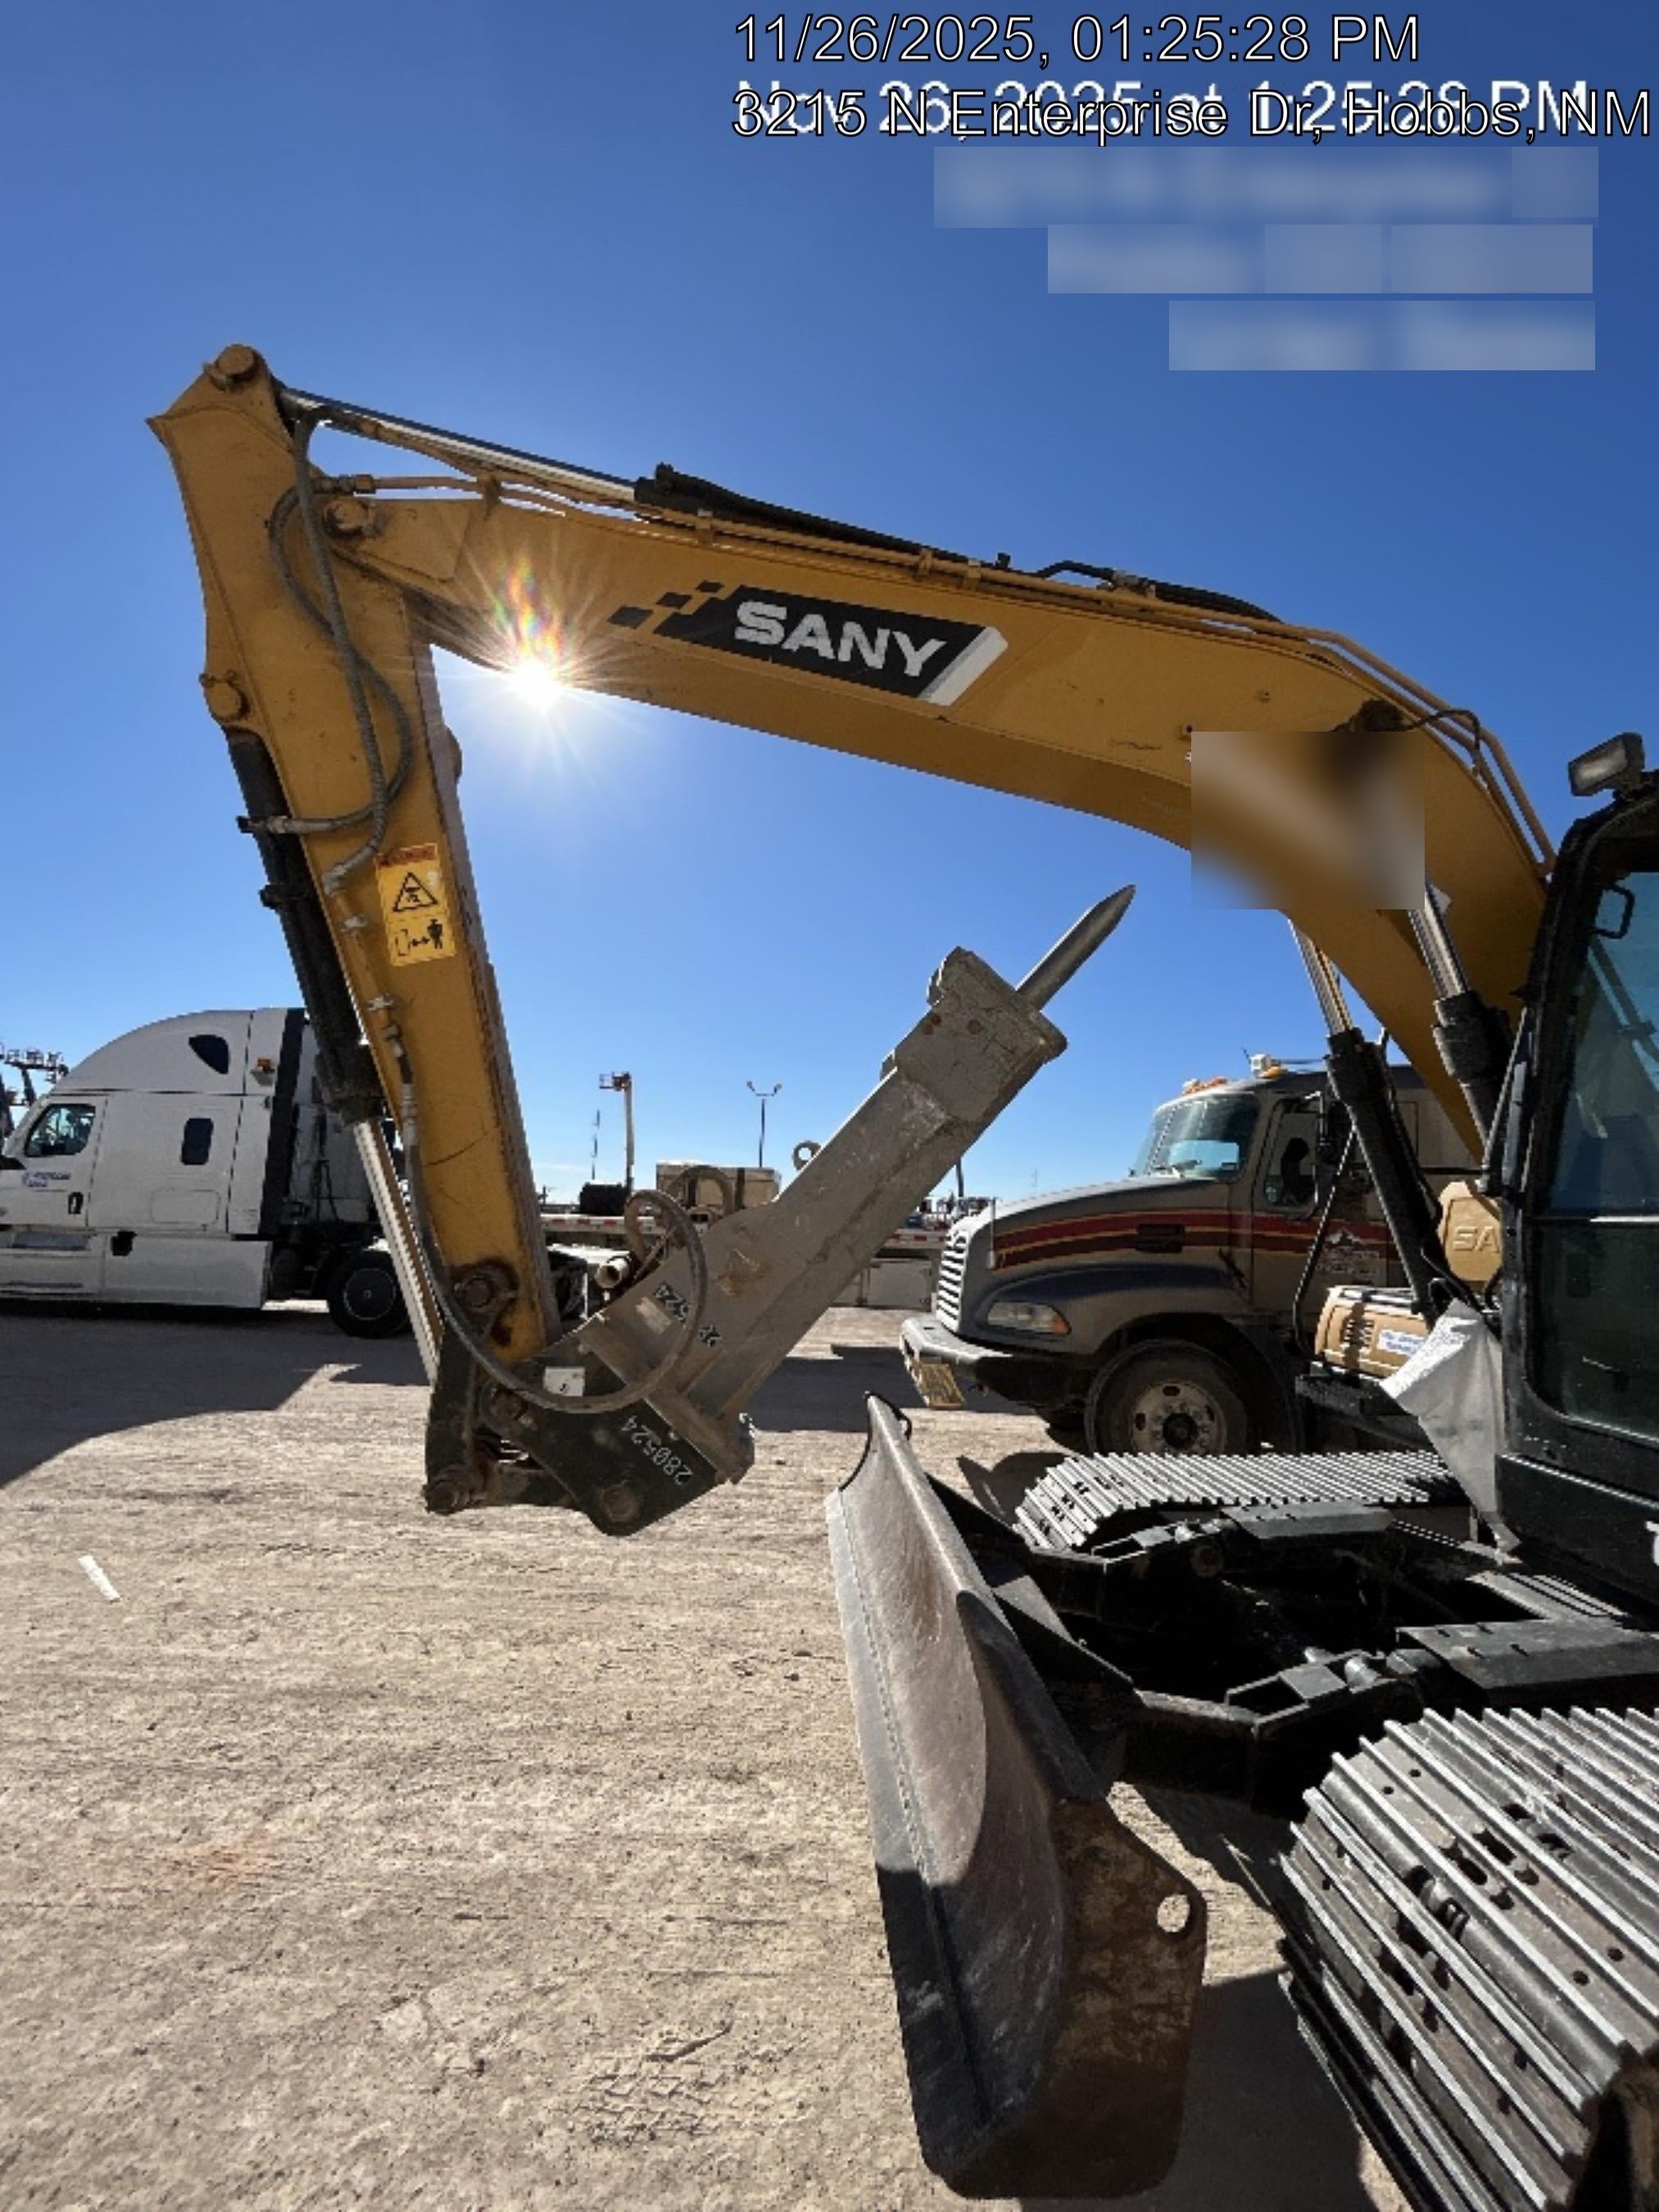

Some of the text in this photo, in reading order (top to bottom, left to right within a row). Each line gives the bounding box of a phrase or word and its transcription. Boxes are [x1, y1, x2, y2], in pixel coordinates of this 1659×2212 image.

[732, 600, 946, 678] SANY
[654, 1282, 723, 1348] 28524
[619, 1415, 693, 1485] 280524
